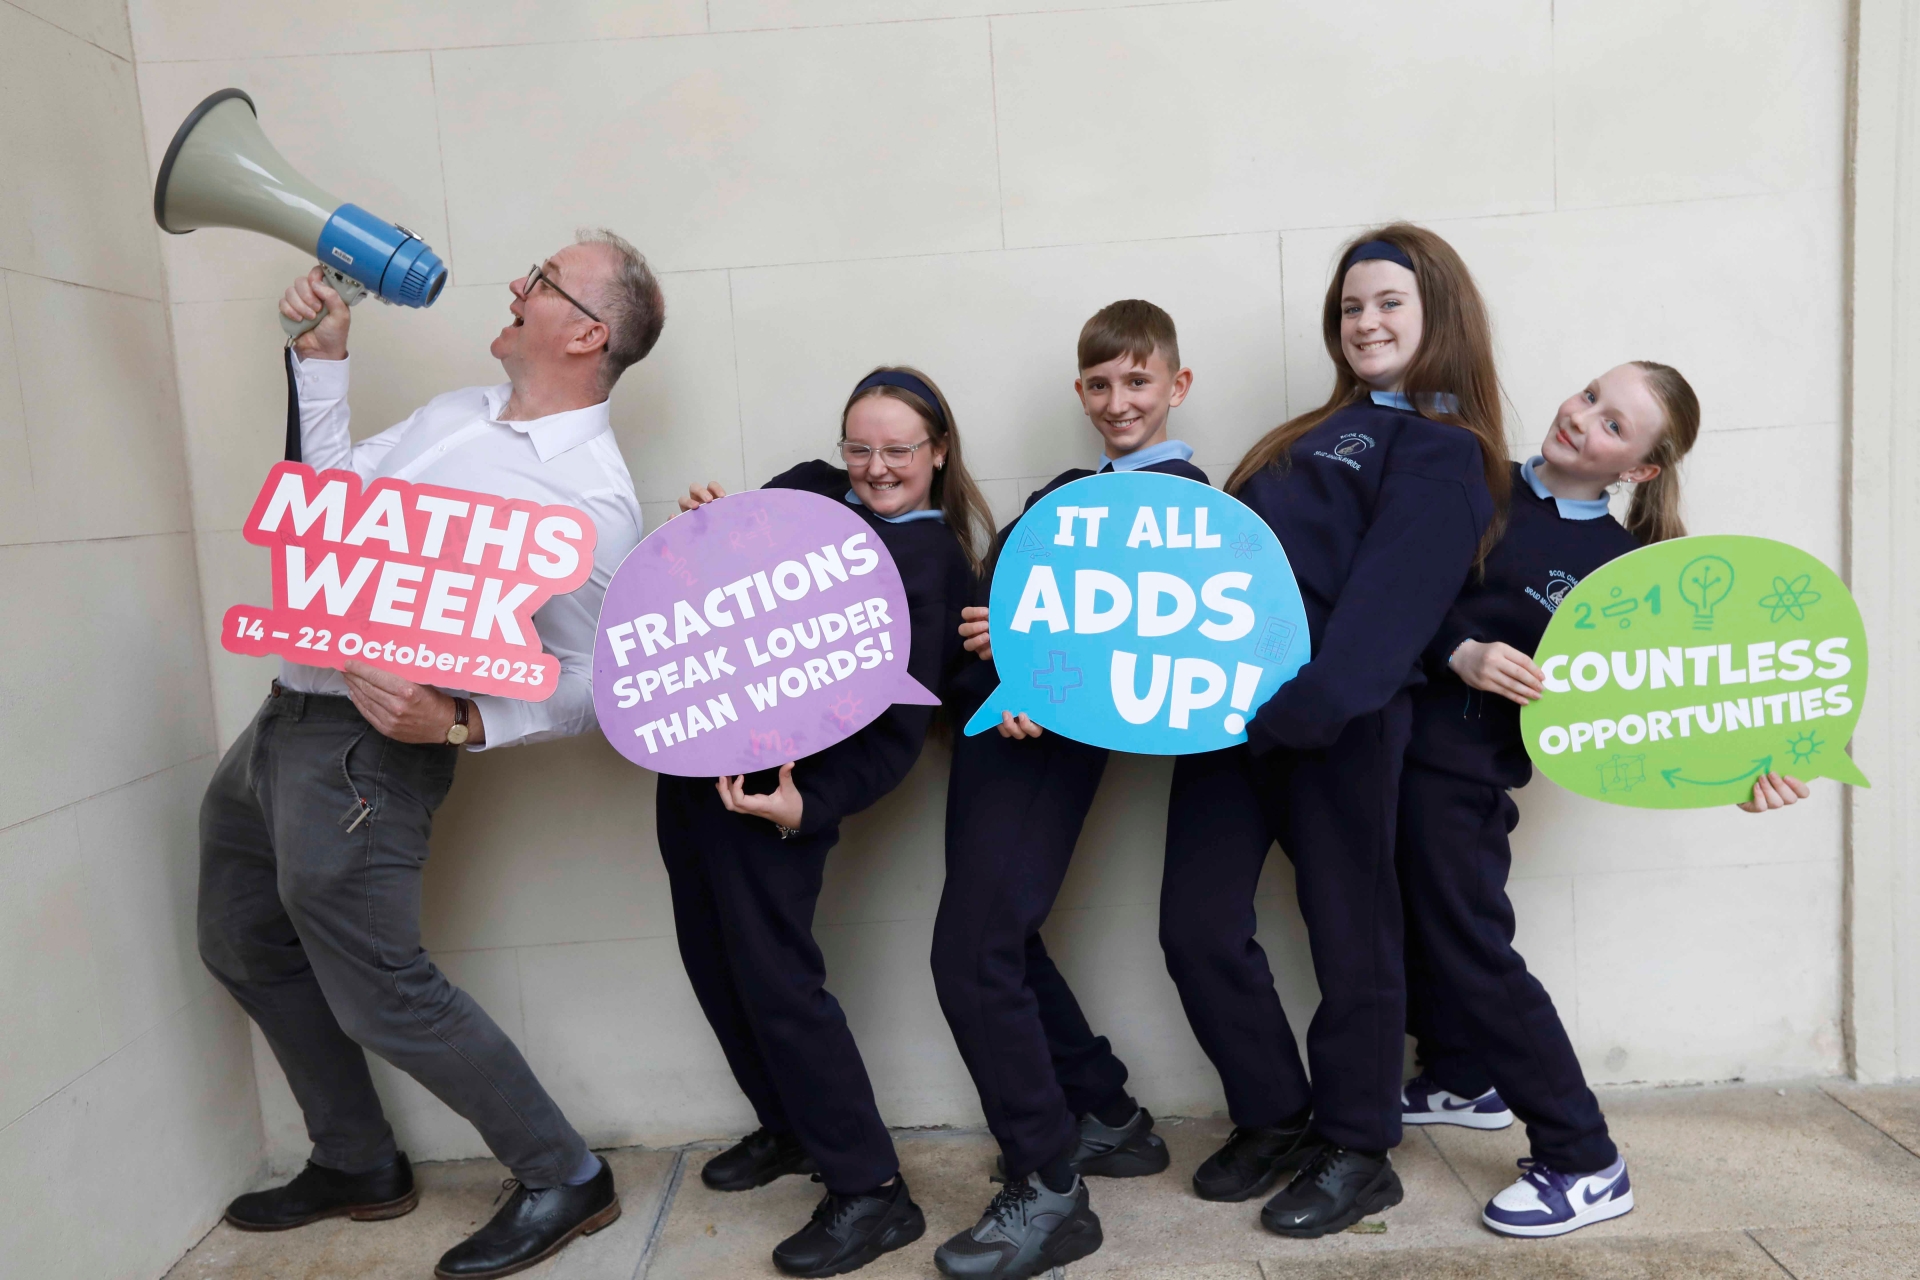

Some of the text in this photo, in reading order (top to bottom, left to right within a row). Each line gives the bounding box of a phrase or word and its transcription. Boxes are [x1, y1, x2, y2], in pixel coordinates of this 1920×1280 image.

[258, 472, 583, 579] MATHS
[1053, 506, 1221, 548] IT ALL
[285, 544, 539, 647] WEEK
[605, 532, 879, 667] FRACTIONS
[1010, 565, 1255, 641] ADDS
[236, 616, 264, 641] 14
[295, 626, 332, 652] 22
[337, 632, 470, 674] October
[473, 655, 545, 686] 2023
[612, 597, 894, 709] SPEAK LOUDER
[634, 631, 894, 754] THAN WORDS!
[1110, 650, 1264, 735] UP!
[1540, 637, 1852, 693] COUNTLESS
[1539, 684, 1853, 755] OPPORTUNITIES
